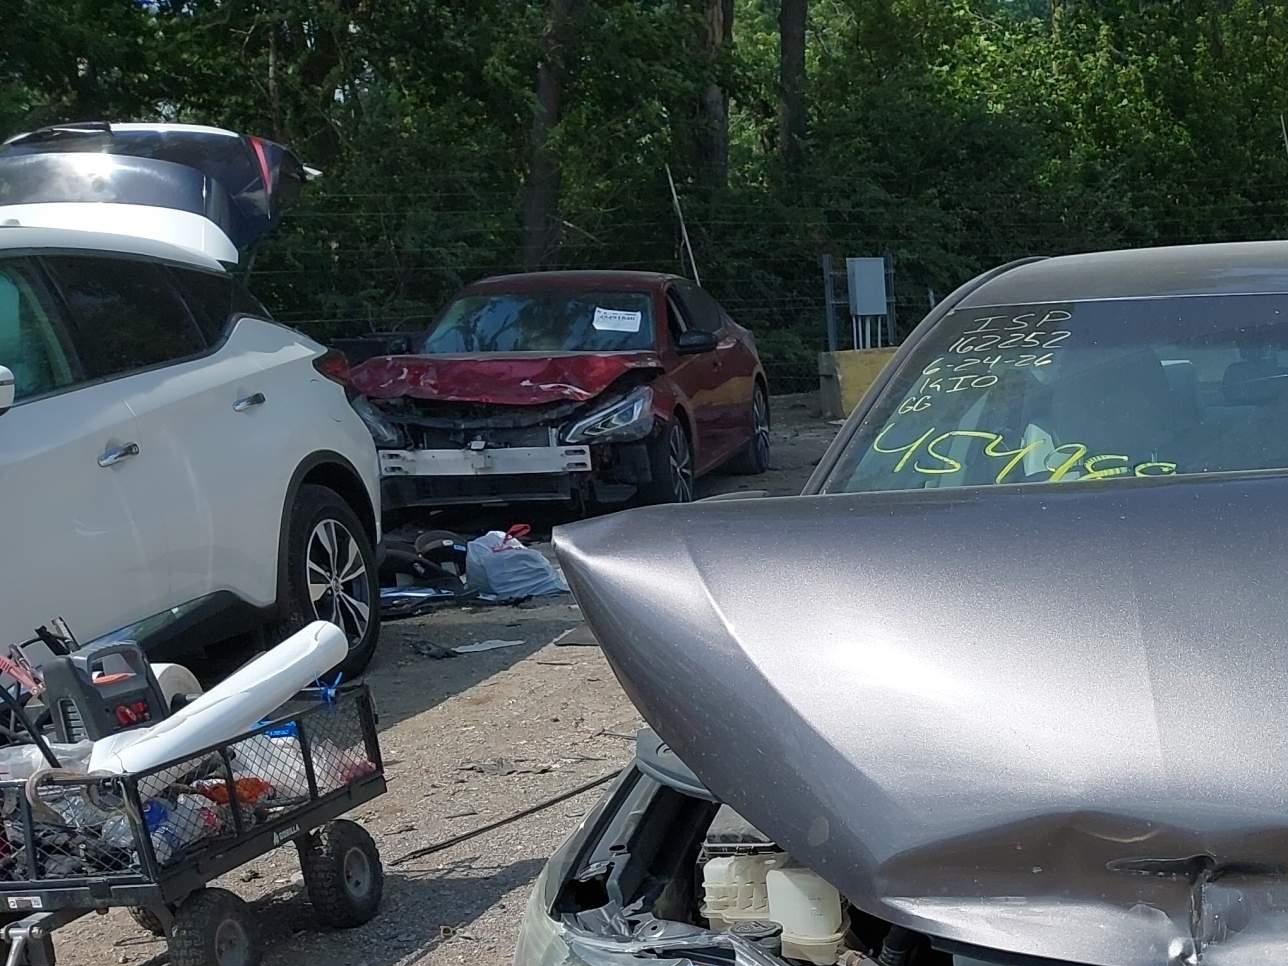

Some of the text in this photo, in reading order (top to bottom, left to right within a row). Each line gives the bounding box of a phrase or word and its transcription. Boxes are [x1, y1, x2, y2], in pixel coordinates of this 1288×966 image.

[963, 310, 1072, 334] ISP
[948, 331, 1072, 353] 162252
[922, 353, 1054, 375] 6-24-26
